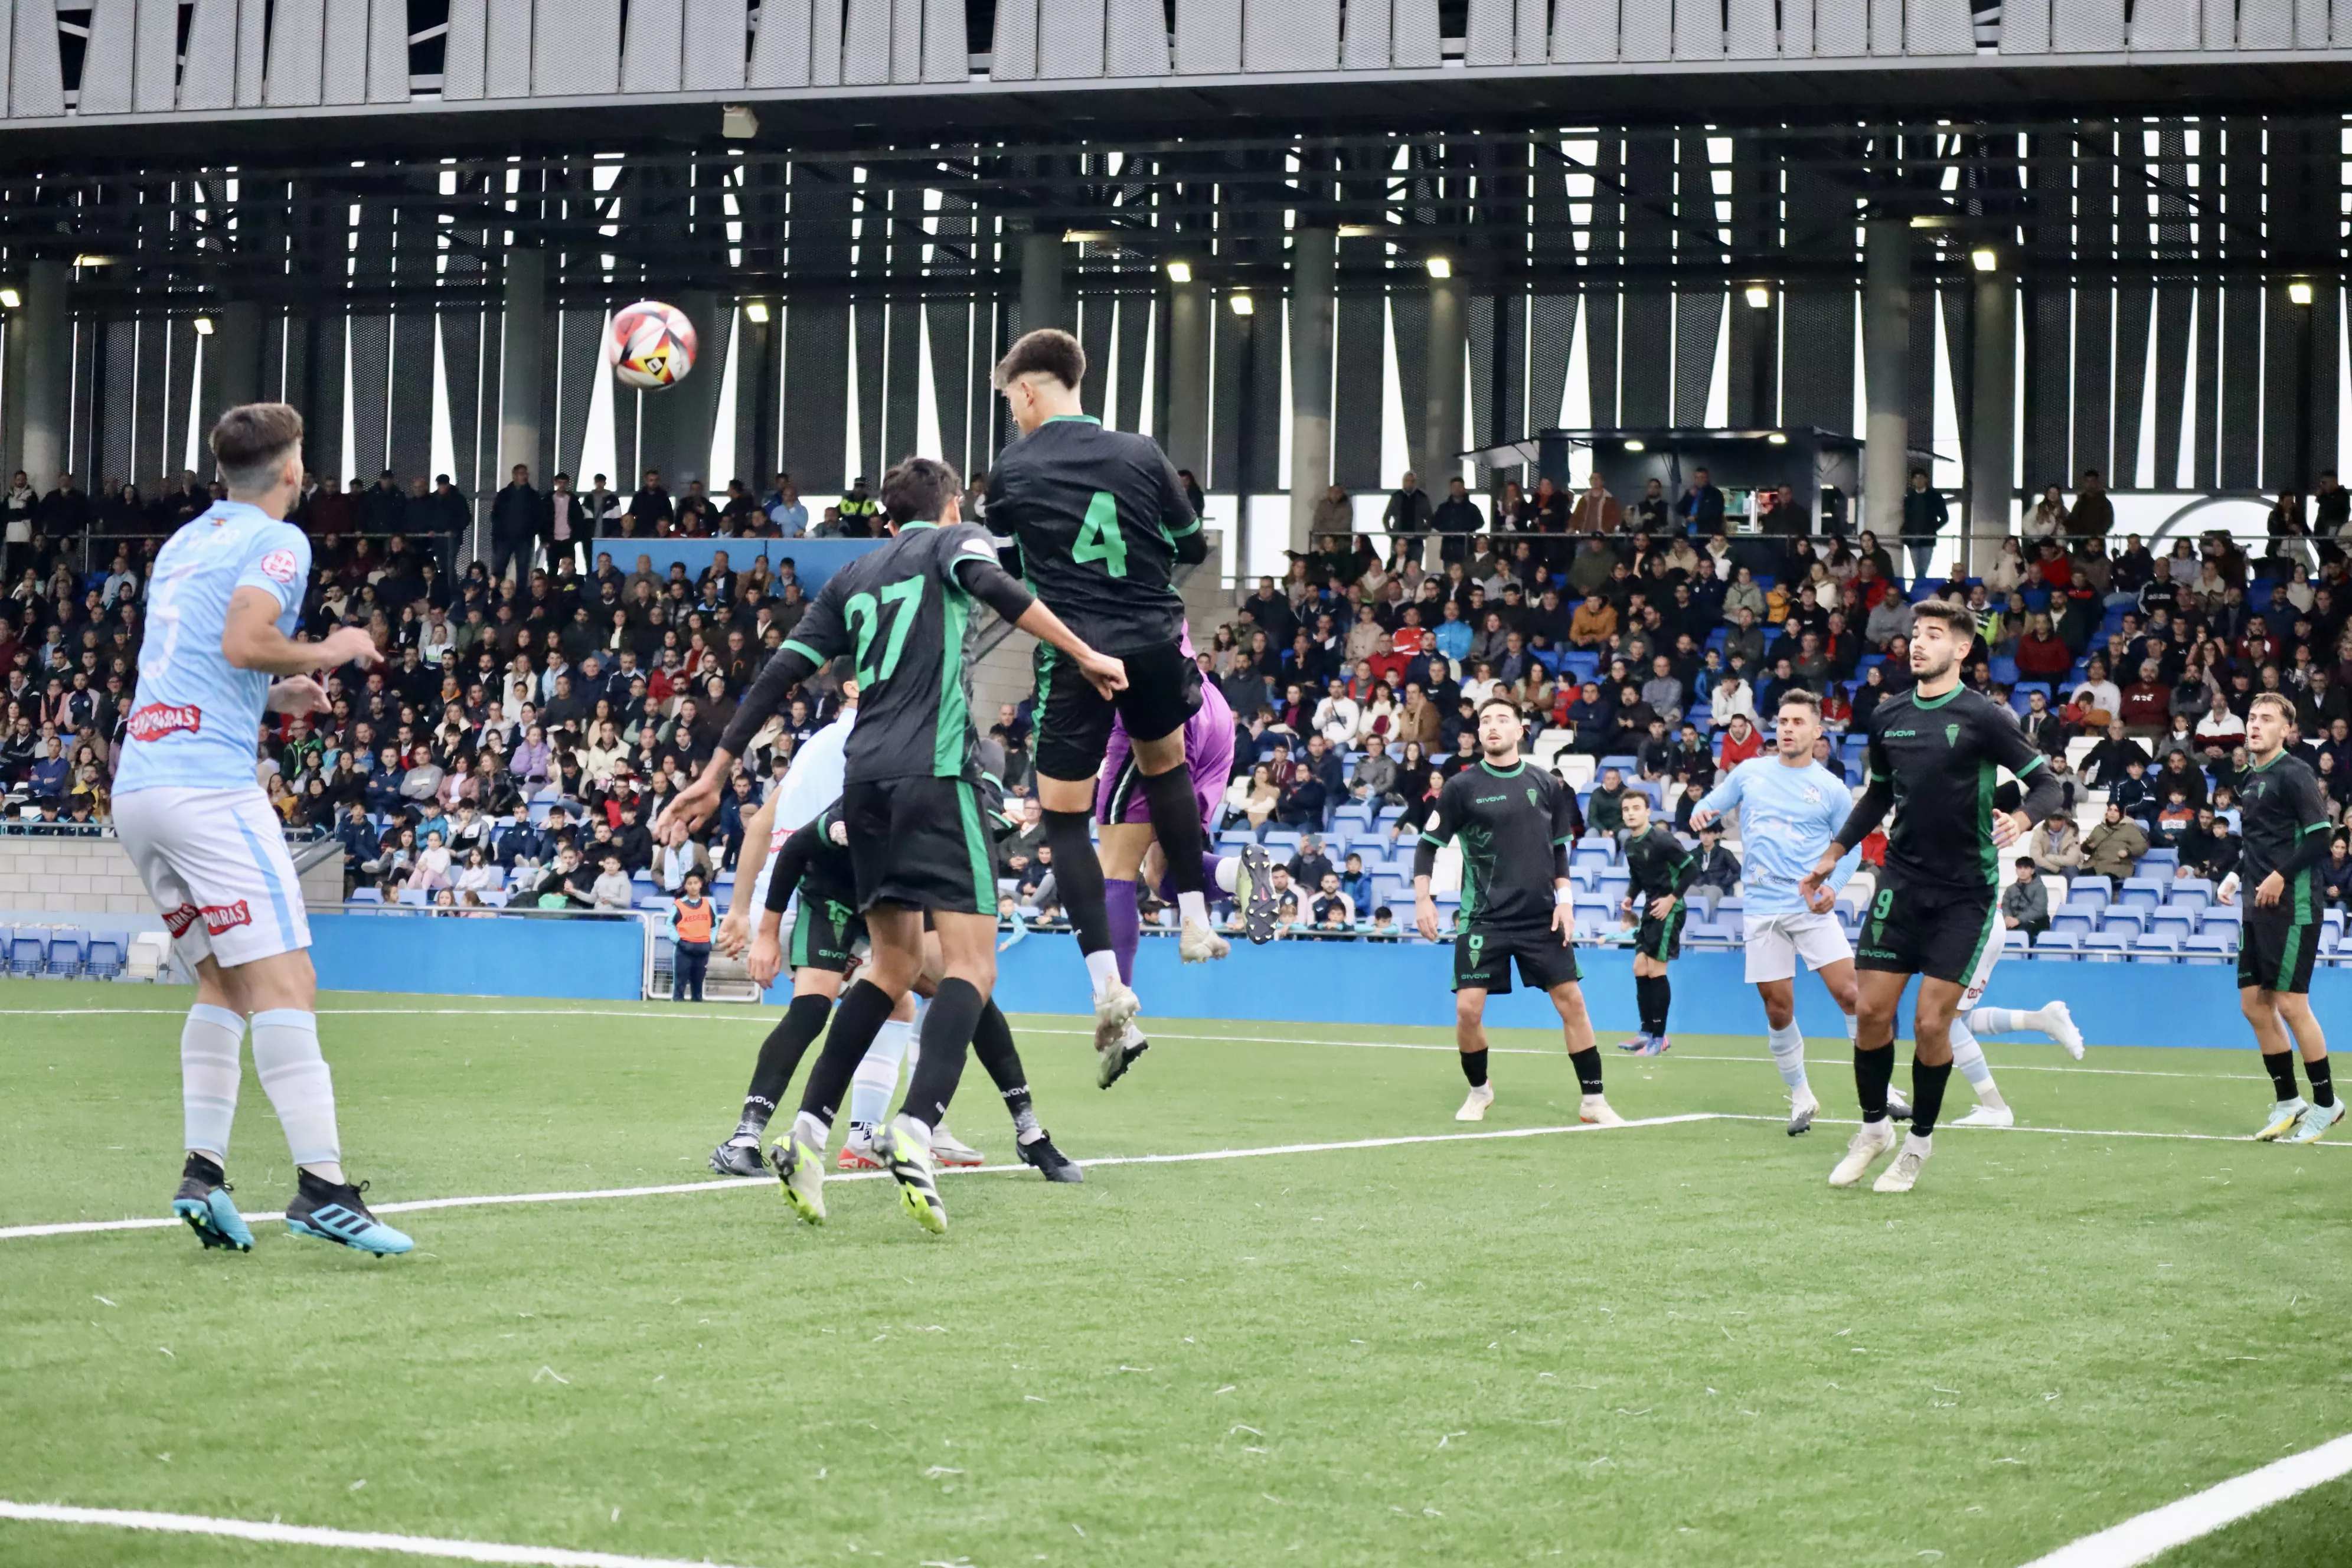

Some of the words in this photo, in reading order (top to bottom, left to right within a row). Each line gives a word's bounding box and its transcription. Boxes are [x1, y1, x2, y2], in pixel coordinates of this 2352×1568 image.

[1072, 492, 1127, 577] 4
[845, 575, 925, 691] 27
[1476, 795, 1507, 803] GIVOVA
[1873, 888, 1893, 919] 9
[1859, 949, 1896, 959] GIVOVA
